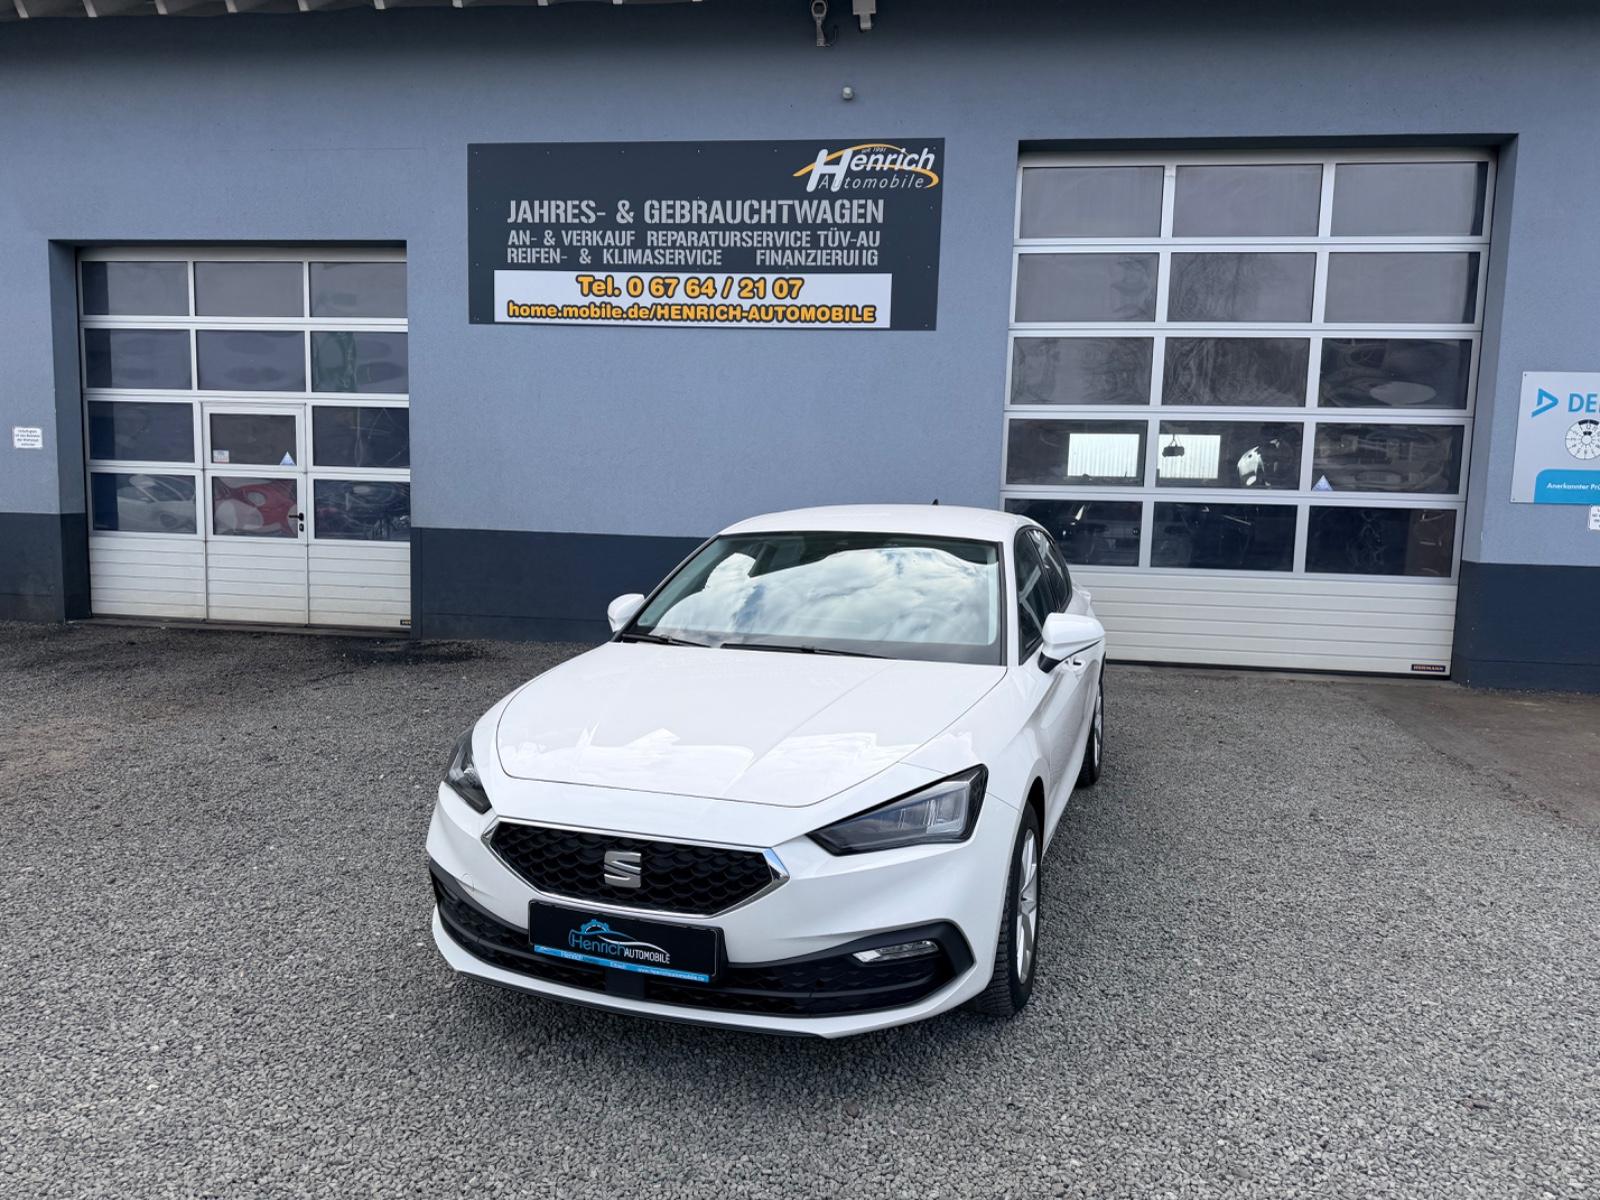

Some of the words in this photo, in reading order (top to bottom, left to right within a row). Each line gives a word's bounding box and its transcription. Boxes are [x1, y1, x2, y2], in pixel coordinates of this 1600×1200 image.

[806, 148, 935, 193] Henrich
[819, 174, 924, 189] Atomobile
[507, 199, 606, 224] JAHRES-
[616, 199, 634, 224] &
[644, 199, 884, 224] GEBRAUCHTWAGEN
[508, 230, 537, 246] AN-
[543, 230, 556, 246] &
[561, 230, 635, 246] VERKAUF
[647, 231, 811, 247] REPARATURSERVICE
[817, 227, 881, 247] TÜV-AU
[507, 248, 568, 264] REIFEN-
[579, 248, 591, 264] &
[603, 249, 722, 266] KLIMASERVICE
[576, 274, 622, 297] Tel.
[626, 275, 644, 298] 0
[649, 276, 680, 298] 67
[684, 276, 717, 299] 64
[721, 276, 734, 299] /
[738, 276, 766, 299] 21
[772, 277, 804, 299] 07
[507, 299, 877, 324] home.mobile.de/HENRICH-AUTOMOBILE
[1568, 392, 1600, 413] DE
[1546, 482, 1589, 490] Anerkannter
[571, 933, 625, 956] Henrich
[624, 947, 671, 964] AUTOMOBILE
